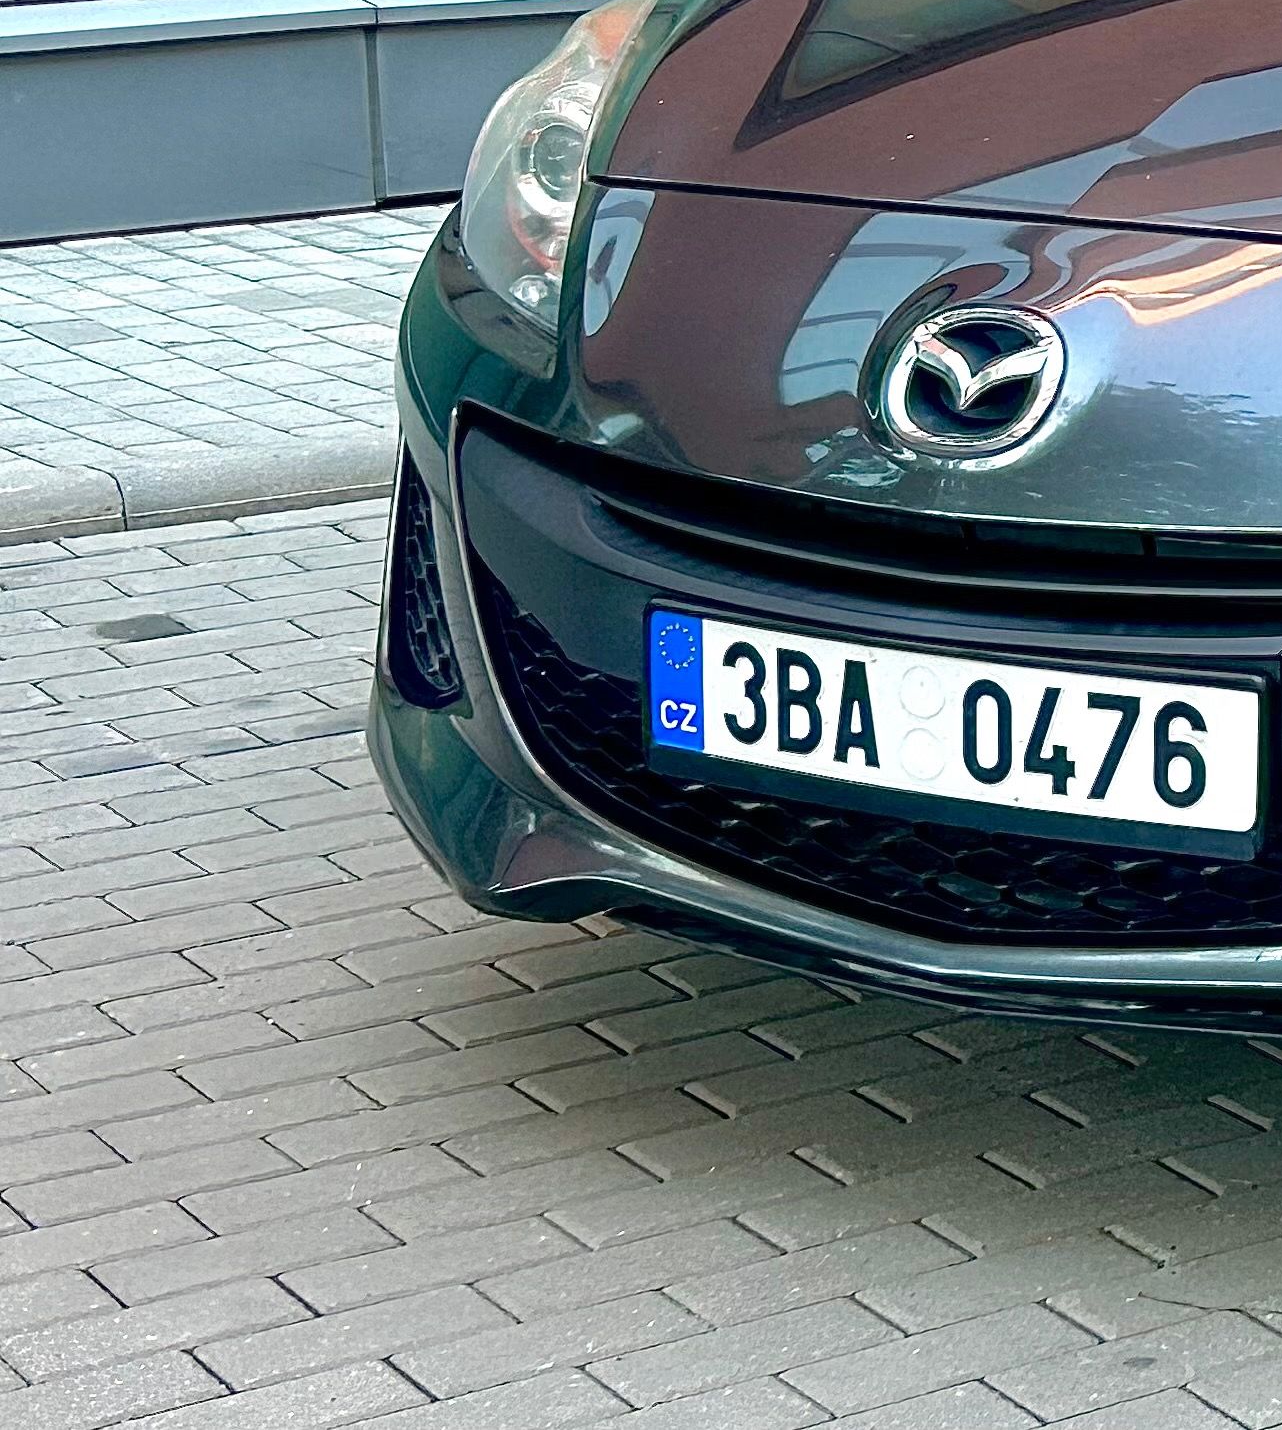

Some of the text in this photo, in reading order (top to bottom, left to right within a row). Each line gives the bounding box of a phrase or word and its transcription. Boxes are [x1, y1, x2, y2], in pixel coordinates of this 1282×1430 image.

[660, 699, 698, 733] CZ
[722, 640, 1208, 809] 3BA 0476
